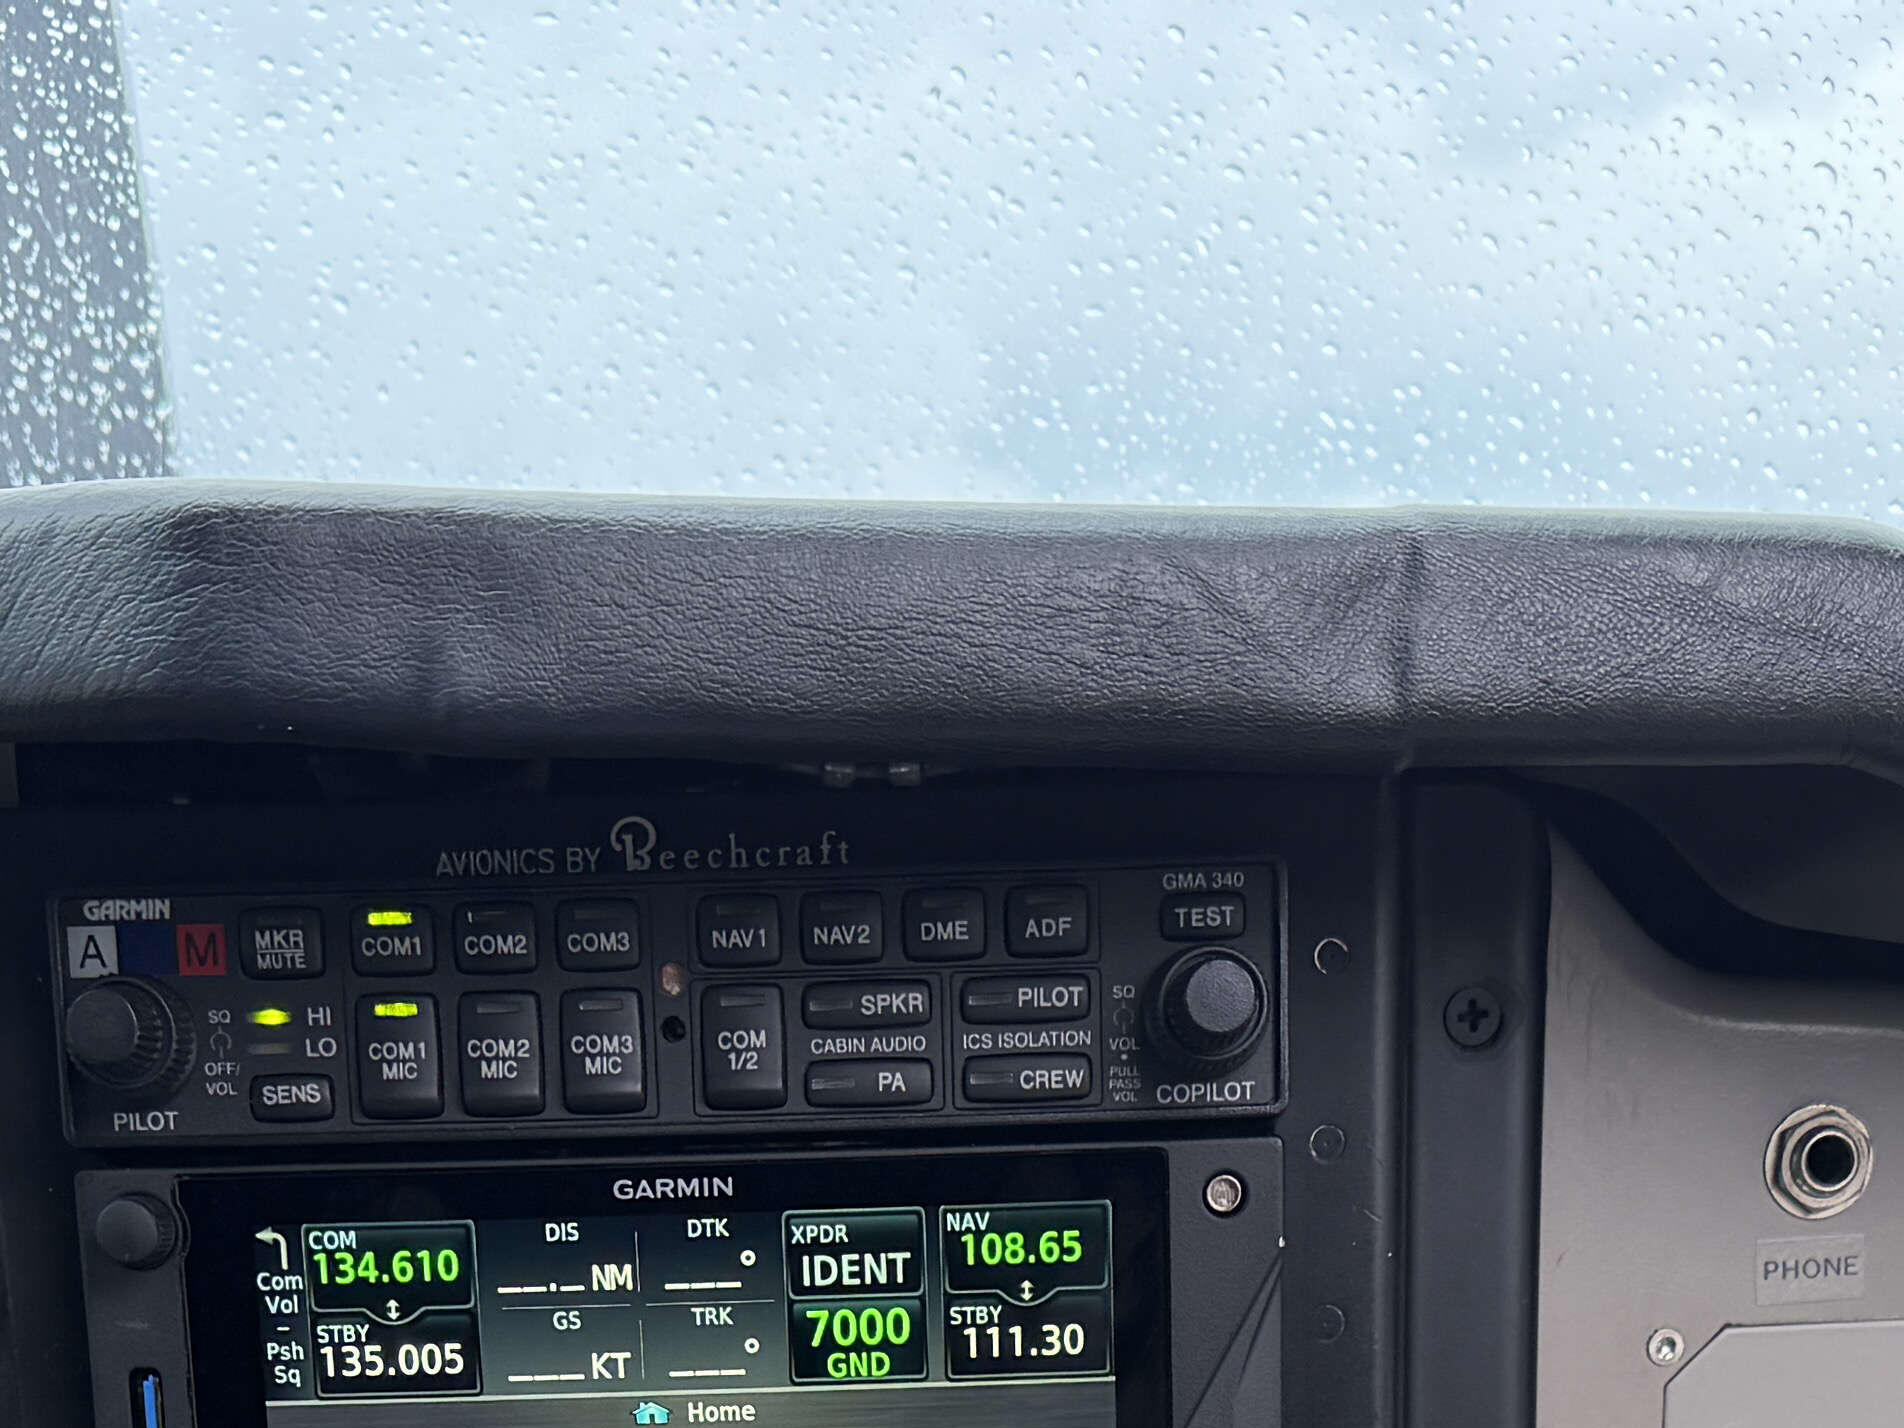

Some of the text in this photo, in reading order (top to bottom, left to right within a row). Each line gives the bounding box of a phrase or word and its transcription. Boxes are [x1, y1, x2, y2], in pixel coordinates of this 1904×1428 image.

[436, 815, 851, 877] AVIONICS BY Beechcraft
[1162, 872, 1244, 890] GMA 340
[83, 899, 171, 922] GARMIN
[1175, 907, 1235, 928] TEST
[920, 921, 969, 941] DME
[464, 935, 527, 956] COM2
[860, 994, 923, 1015] SPKR
[1020, 1069, 1084, 1090] CREW
[262, 1084, 321, 1105] SENS
[613, 1176, 734, 1200] GARMIN
[545, 1223, 580, 1243] DIS
[961, 1230, 1082, 1266] 108.65
[312, 1248, 459, 1285] 134.610
[591, 1264, 633, 1291] NM
[801, 1251, 911, 1287] IDENT
[1762, 1255, 1859, 1280] PHONE
[805, 1307, 911, 1348] 7000
[963, 1323, 1085, 1359] 111.30
[320, 1343, 464, 1379] 135.005
[687, 1401, 756, 1422] Home
